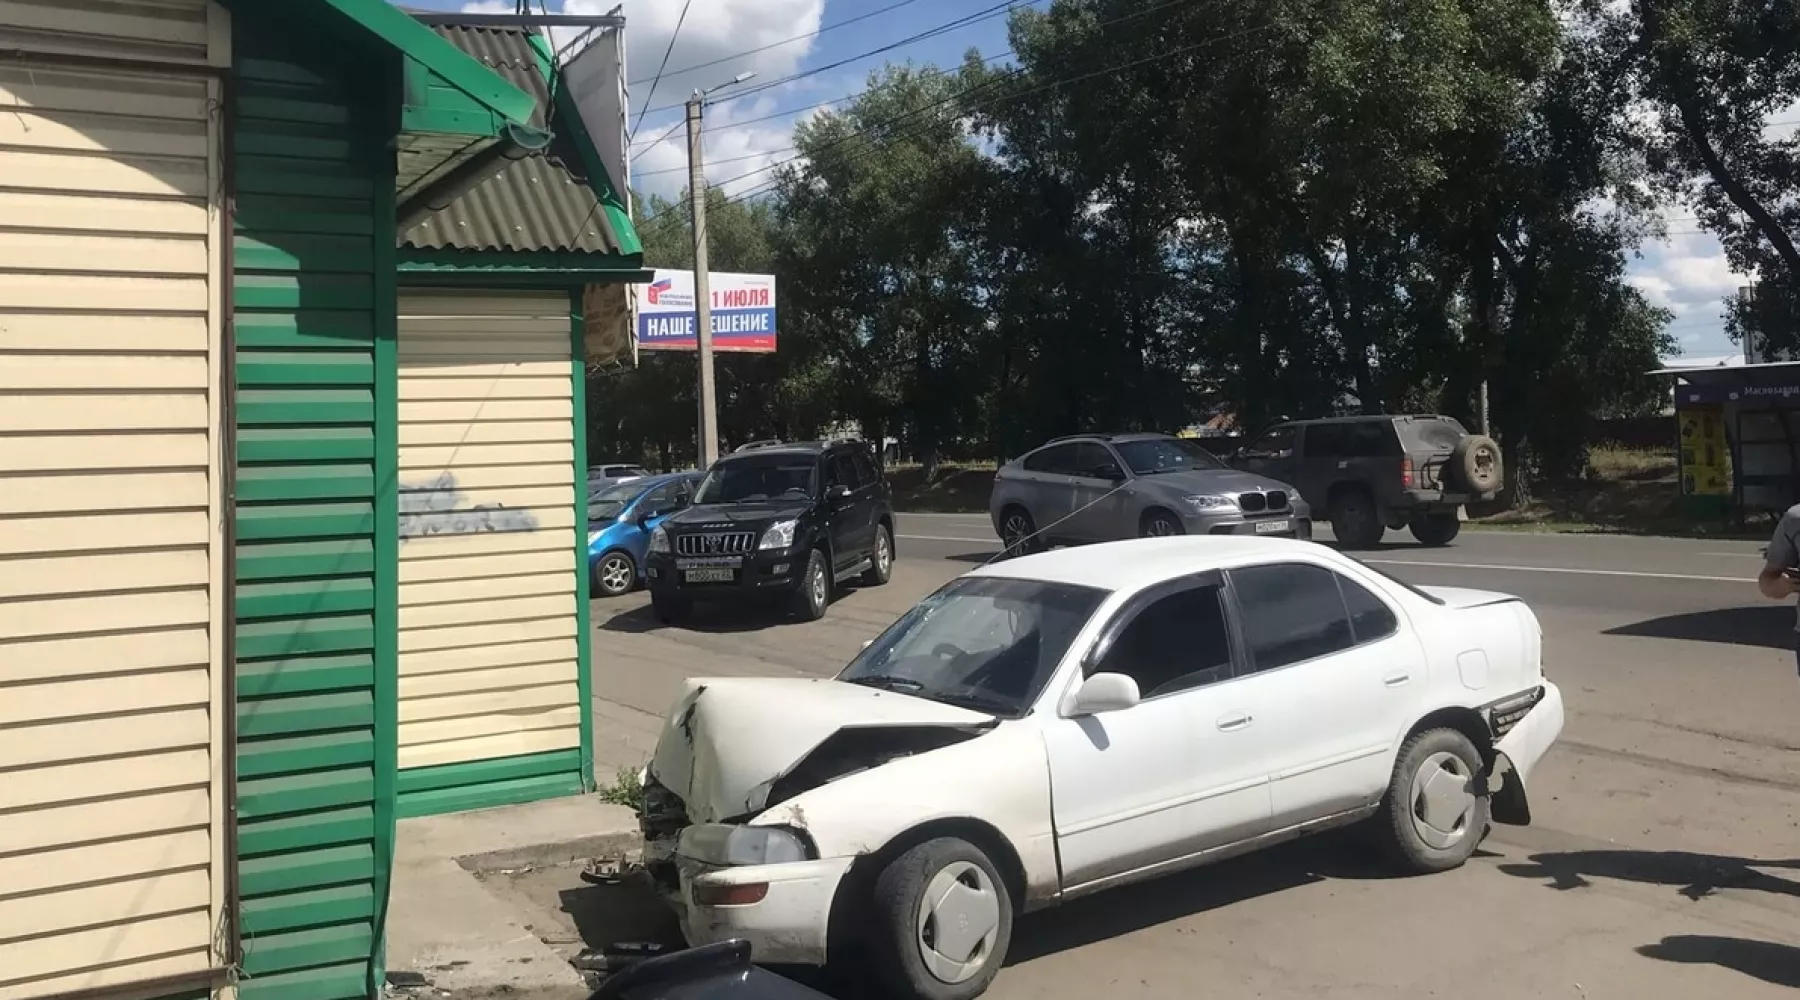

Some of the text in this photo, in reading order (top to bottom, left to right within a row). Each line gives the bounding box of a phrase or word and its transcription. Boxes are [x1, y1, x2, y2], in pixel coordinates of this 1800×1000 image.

[712, 288, 769, 308] 1 ИЮЛЯ
[647, 313, 769, 336] НАШЕ ЕШЕНИЕ
